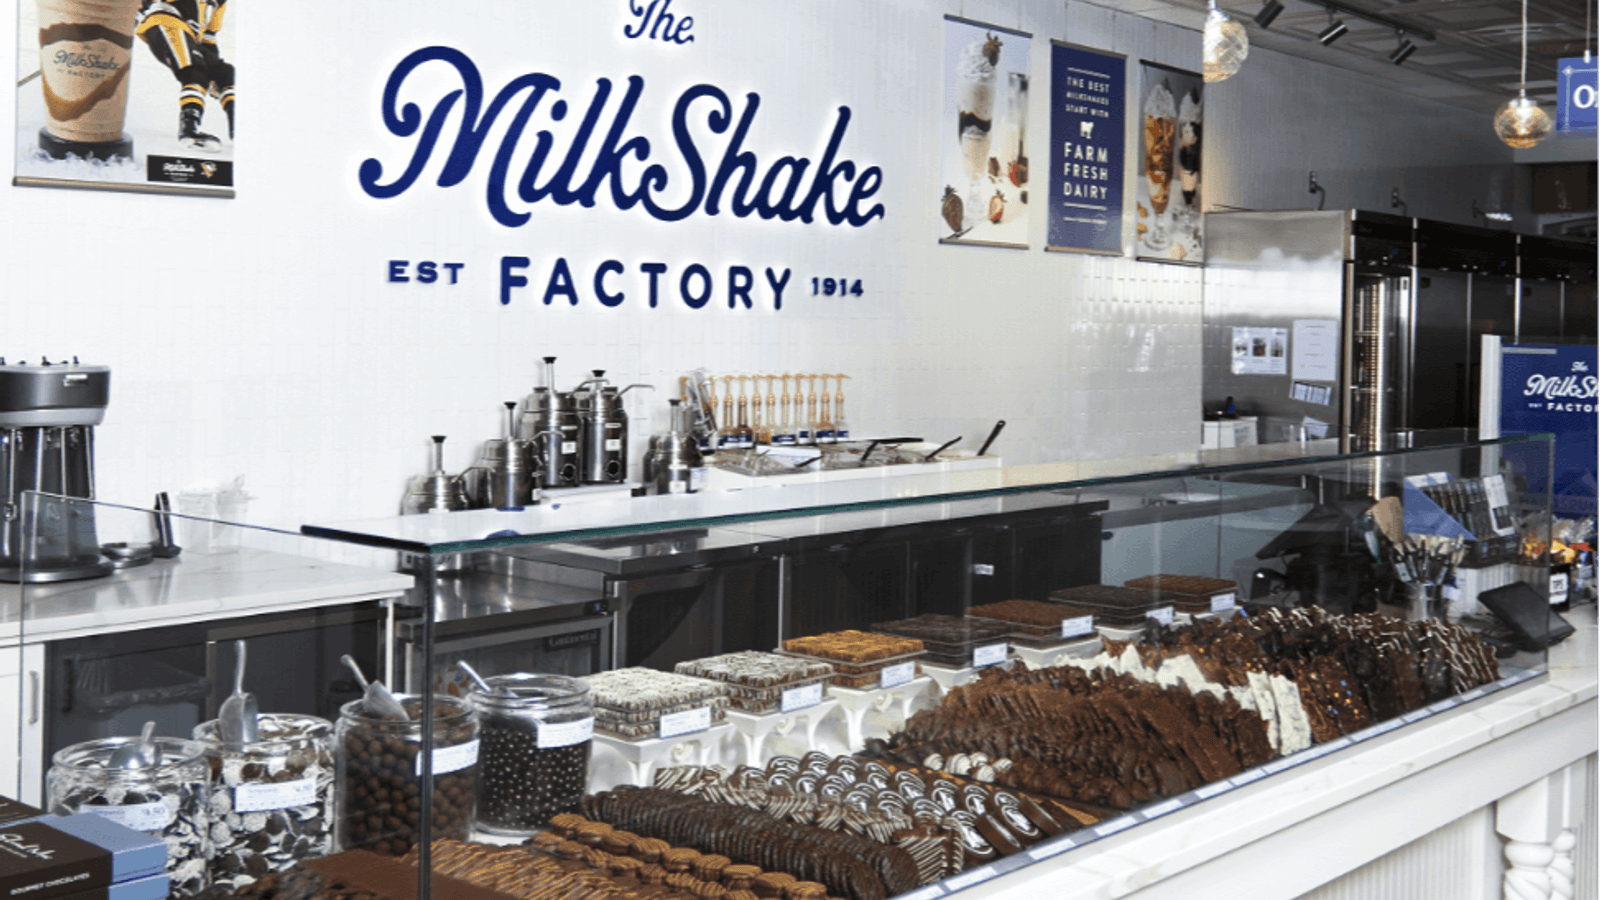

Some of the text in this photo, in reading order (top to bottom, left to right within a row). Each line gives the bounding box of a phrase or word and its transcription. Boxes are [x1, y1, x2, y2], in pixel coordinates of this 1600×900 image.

[625, 0, 694, 44] The
[1066, 76, 1110, 93] THE BEST
[1065, 91, 1110, 106] MILKSHAKES
[1065, 104, 1110, 119] START WITH
[359, 46, 884, 227] MilkShake
[1063, 141, 1109, 163] FARM
[1063, 162, 1108, 181] FRESH
[1063, 181, 1108, 200] DAIRY
[389, 257, 863, 310] EST FACTORY 1914
